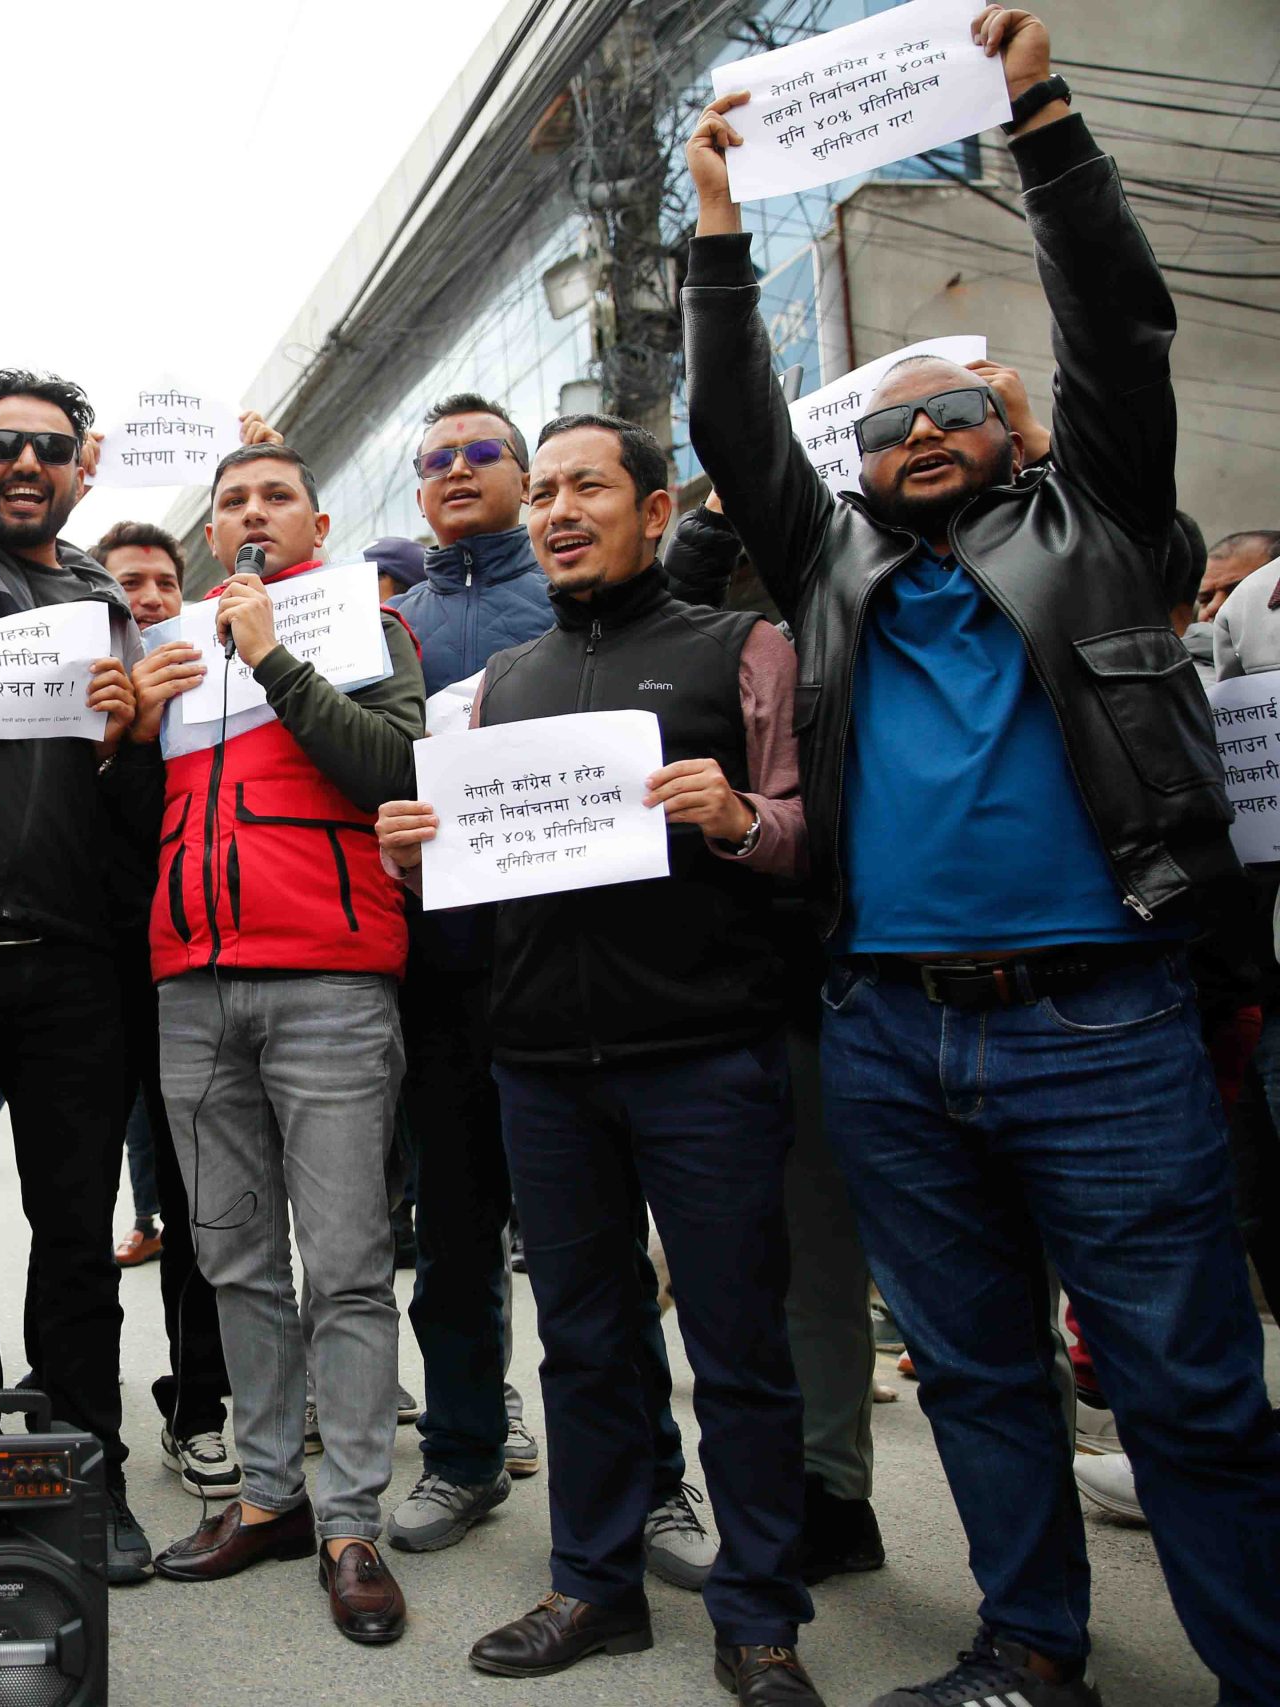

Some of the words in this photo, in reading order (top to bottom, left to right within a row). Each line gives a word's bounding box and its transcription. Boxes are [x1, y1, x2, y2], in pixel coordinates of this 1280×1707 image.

[43, 682, 64, 697] गर
[464, 778, 505, 799] नेपाली
[558, 772, 567, 784] र
[573, 764, 605, 783] हरेक
[457, 806, 494, 827] तहको
[500, 798, 569, 820] निर्वाचनमा
[577, 785, 621, 806] ४०वर्ष
[468, 832, 494, 854] मुनि
[502, 830, 536, 843] ४०%
[543, 816, 615, 839] प्रतिनिधित्व
[564, 845, 587, 858] गर!
